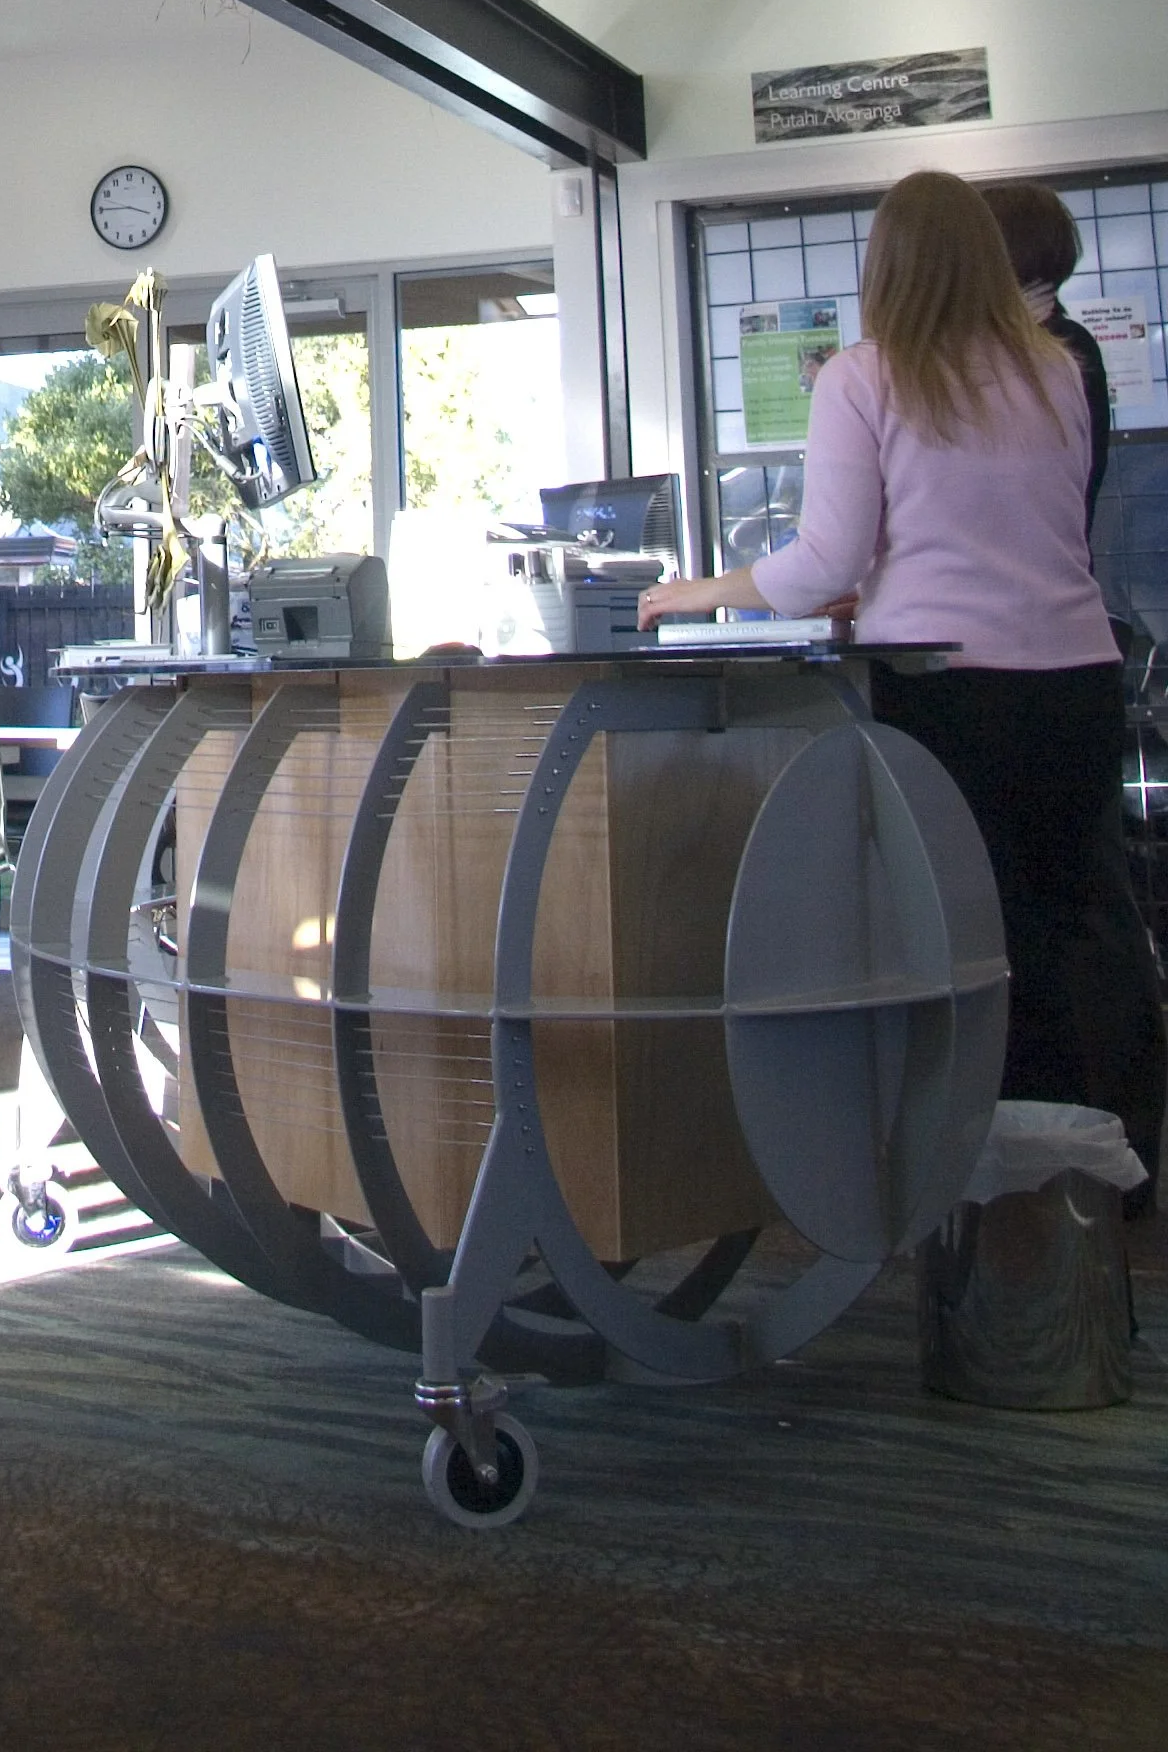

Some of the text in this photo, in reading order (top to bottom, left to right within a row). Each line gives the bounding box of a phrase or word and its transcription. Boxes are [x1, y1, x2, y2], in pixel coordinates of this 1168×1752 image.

[768, 73, 910, 102] Learning Centre
[822, 104, 902, 125] Akoranga
[112, 178, 119, 188] 11
[103, 189, 111, 199] 10
[152, 185, 156, 195] 2
[157, 201, 161, 210] 3
[104, 222, 108, 230] 8
[115, 231, 120, 240] 7
[128, 233, 134, 243] 6
[141, 229, 147, 238] 5
